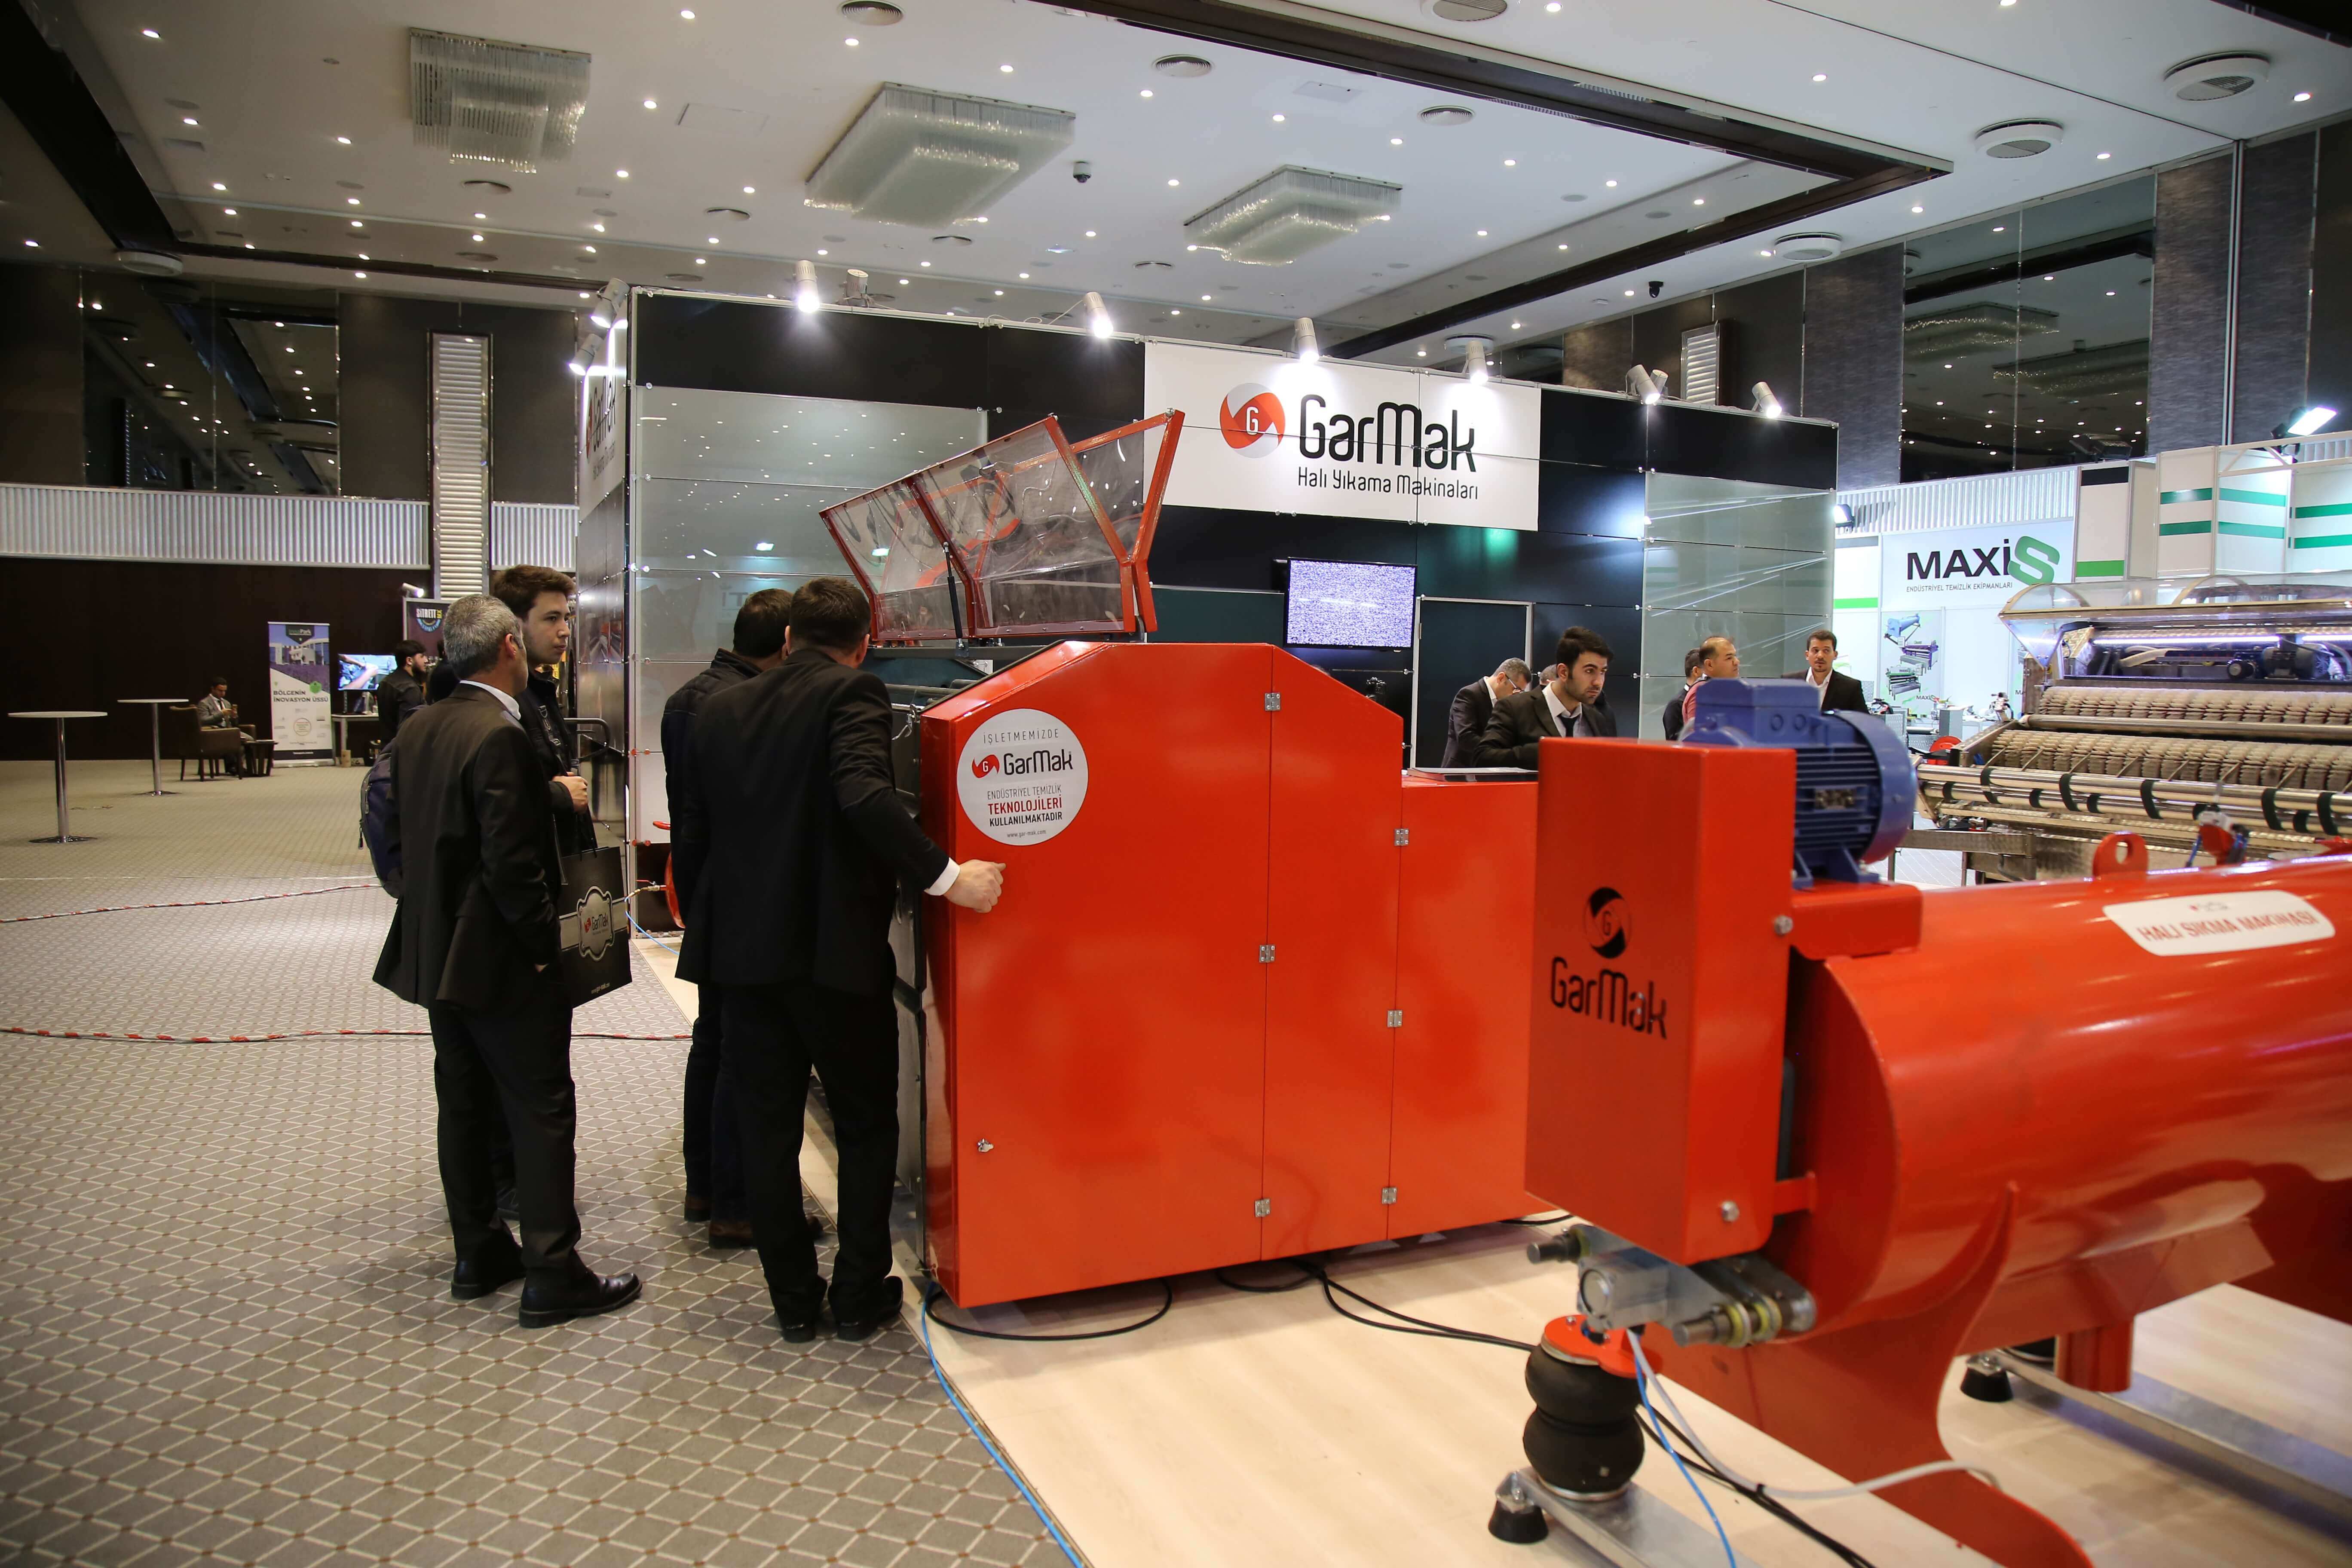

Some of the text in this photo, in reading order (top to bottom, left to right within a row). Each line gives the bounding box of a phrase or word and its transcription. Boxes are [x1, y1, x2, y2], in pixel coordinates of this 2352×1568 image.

[1299, 394, 1476, 472] GarMak
[1298, 467, 1478, 499] Halı Yıkama Makinaları
[1945, 583, 1971, 591] TEMİZLİK
[983, 729, 1059, 744] İŞLETMEMİZDE
[1004, 749, 1073, 775] GarMak
[987, 783, 1062, 800] ENDÜSTRİYEL TEMİZLİK
[988, 794, 1062, 815] TEKNOLOJİLERİ
[990, 812, 1063, 827] KULLANILMAKTADIR
[1551, 956, 1667, 1040] GarMak
